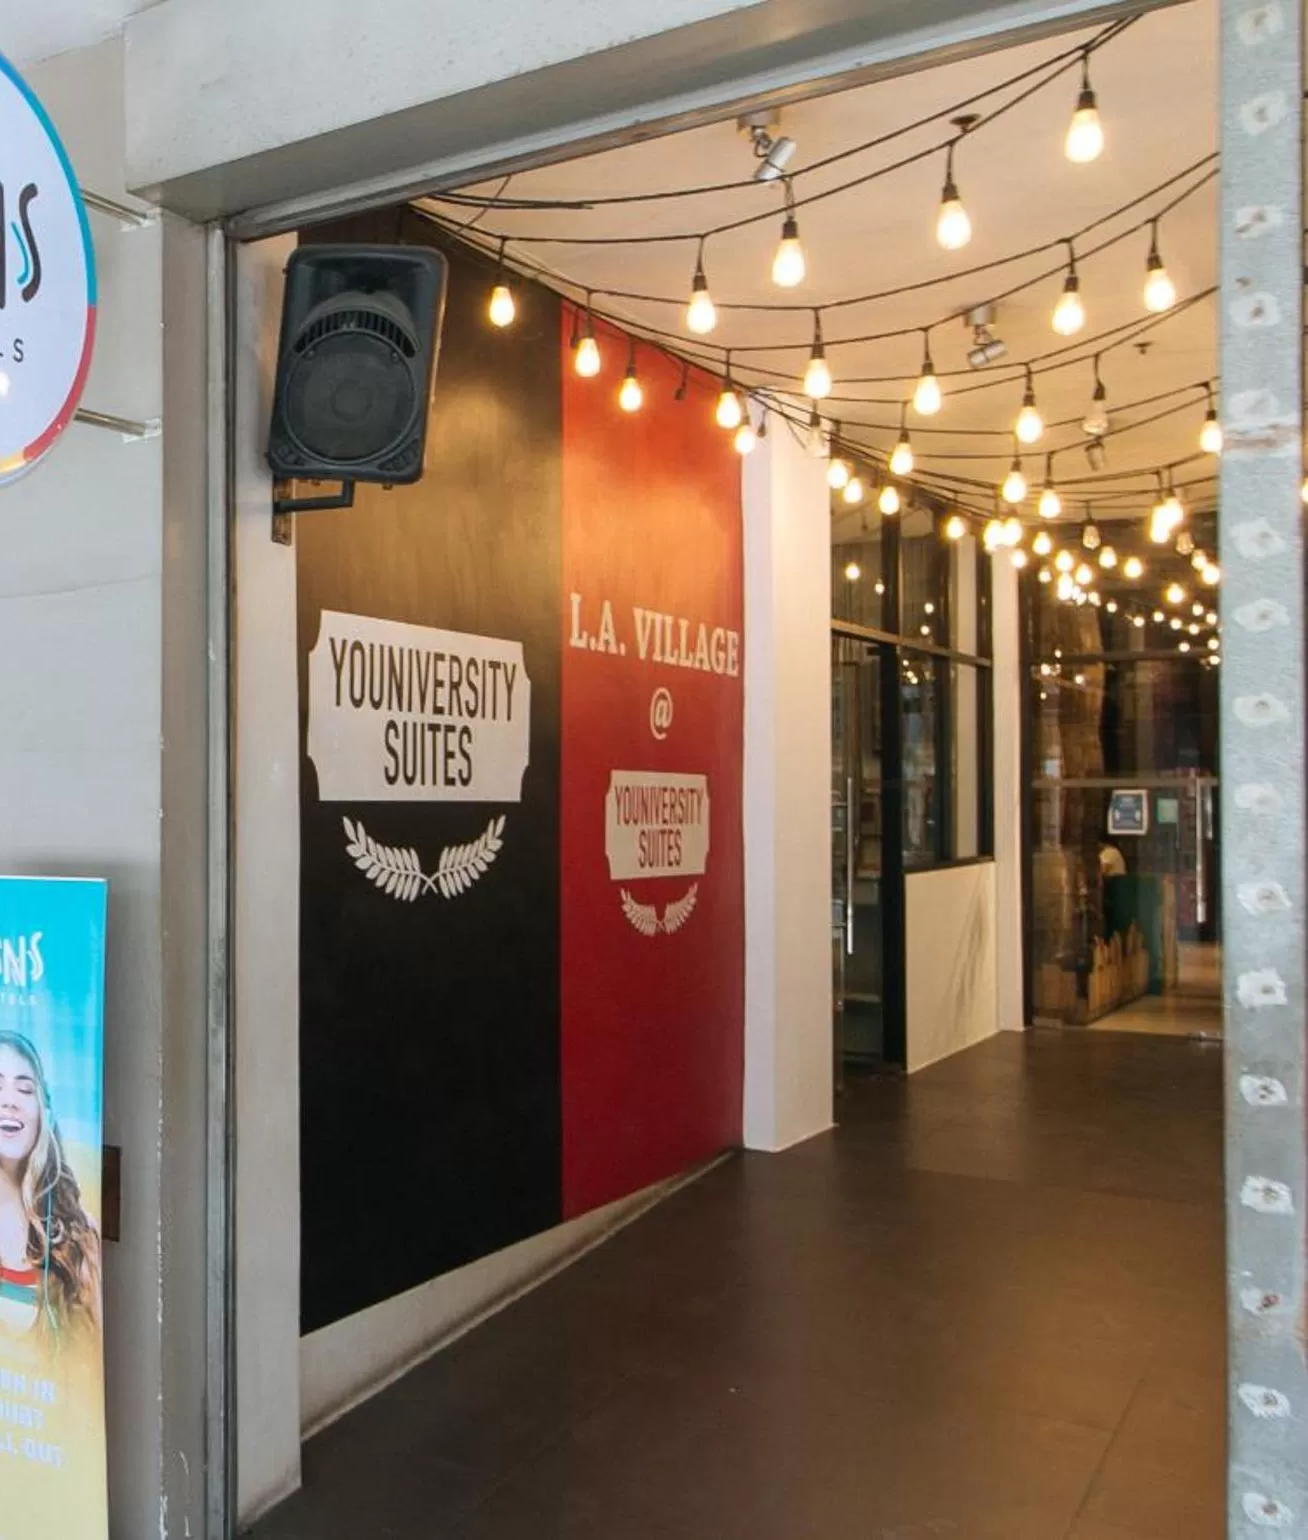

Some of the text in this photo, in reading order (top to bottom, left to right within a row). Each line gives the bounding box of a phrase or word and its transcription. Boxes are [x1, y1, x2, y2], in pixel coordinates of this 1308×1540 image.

[569, 592, 740, 677] L.A. VILLAGE
[329, 636, 518, 722] YOUNIVERSITY
[649, 687, 674, 740] @
[384, 720, 474, 788] SUITES
[614, 785, 705, 827] YOUNIVERSITY
[638, 829, 683, 869] SUITES
[23, 1439, 63, 1468] OUT
